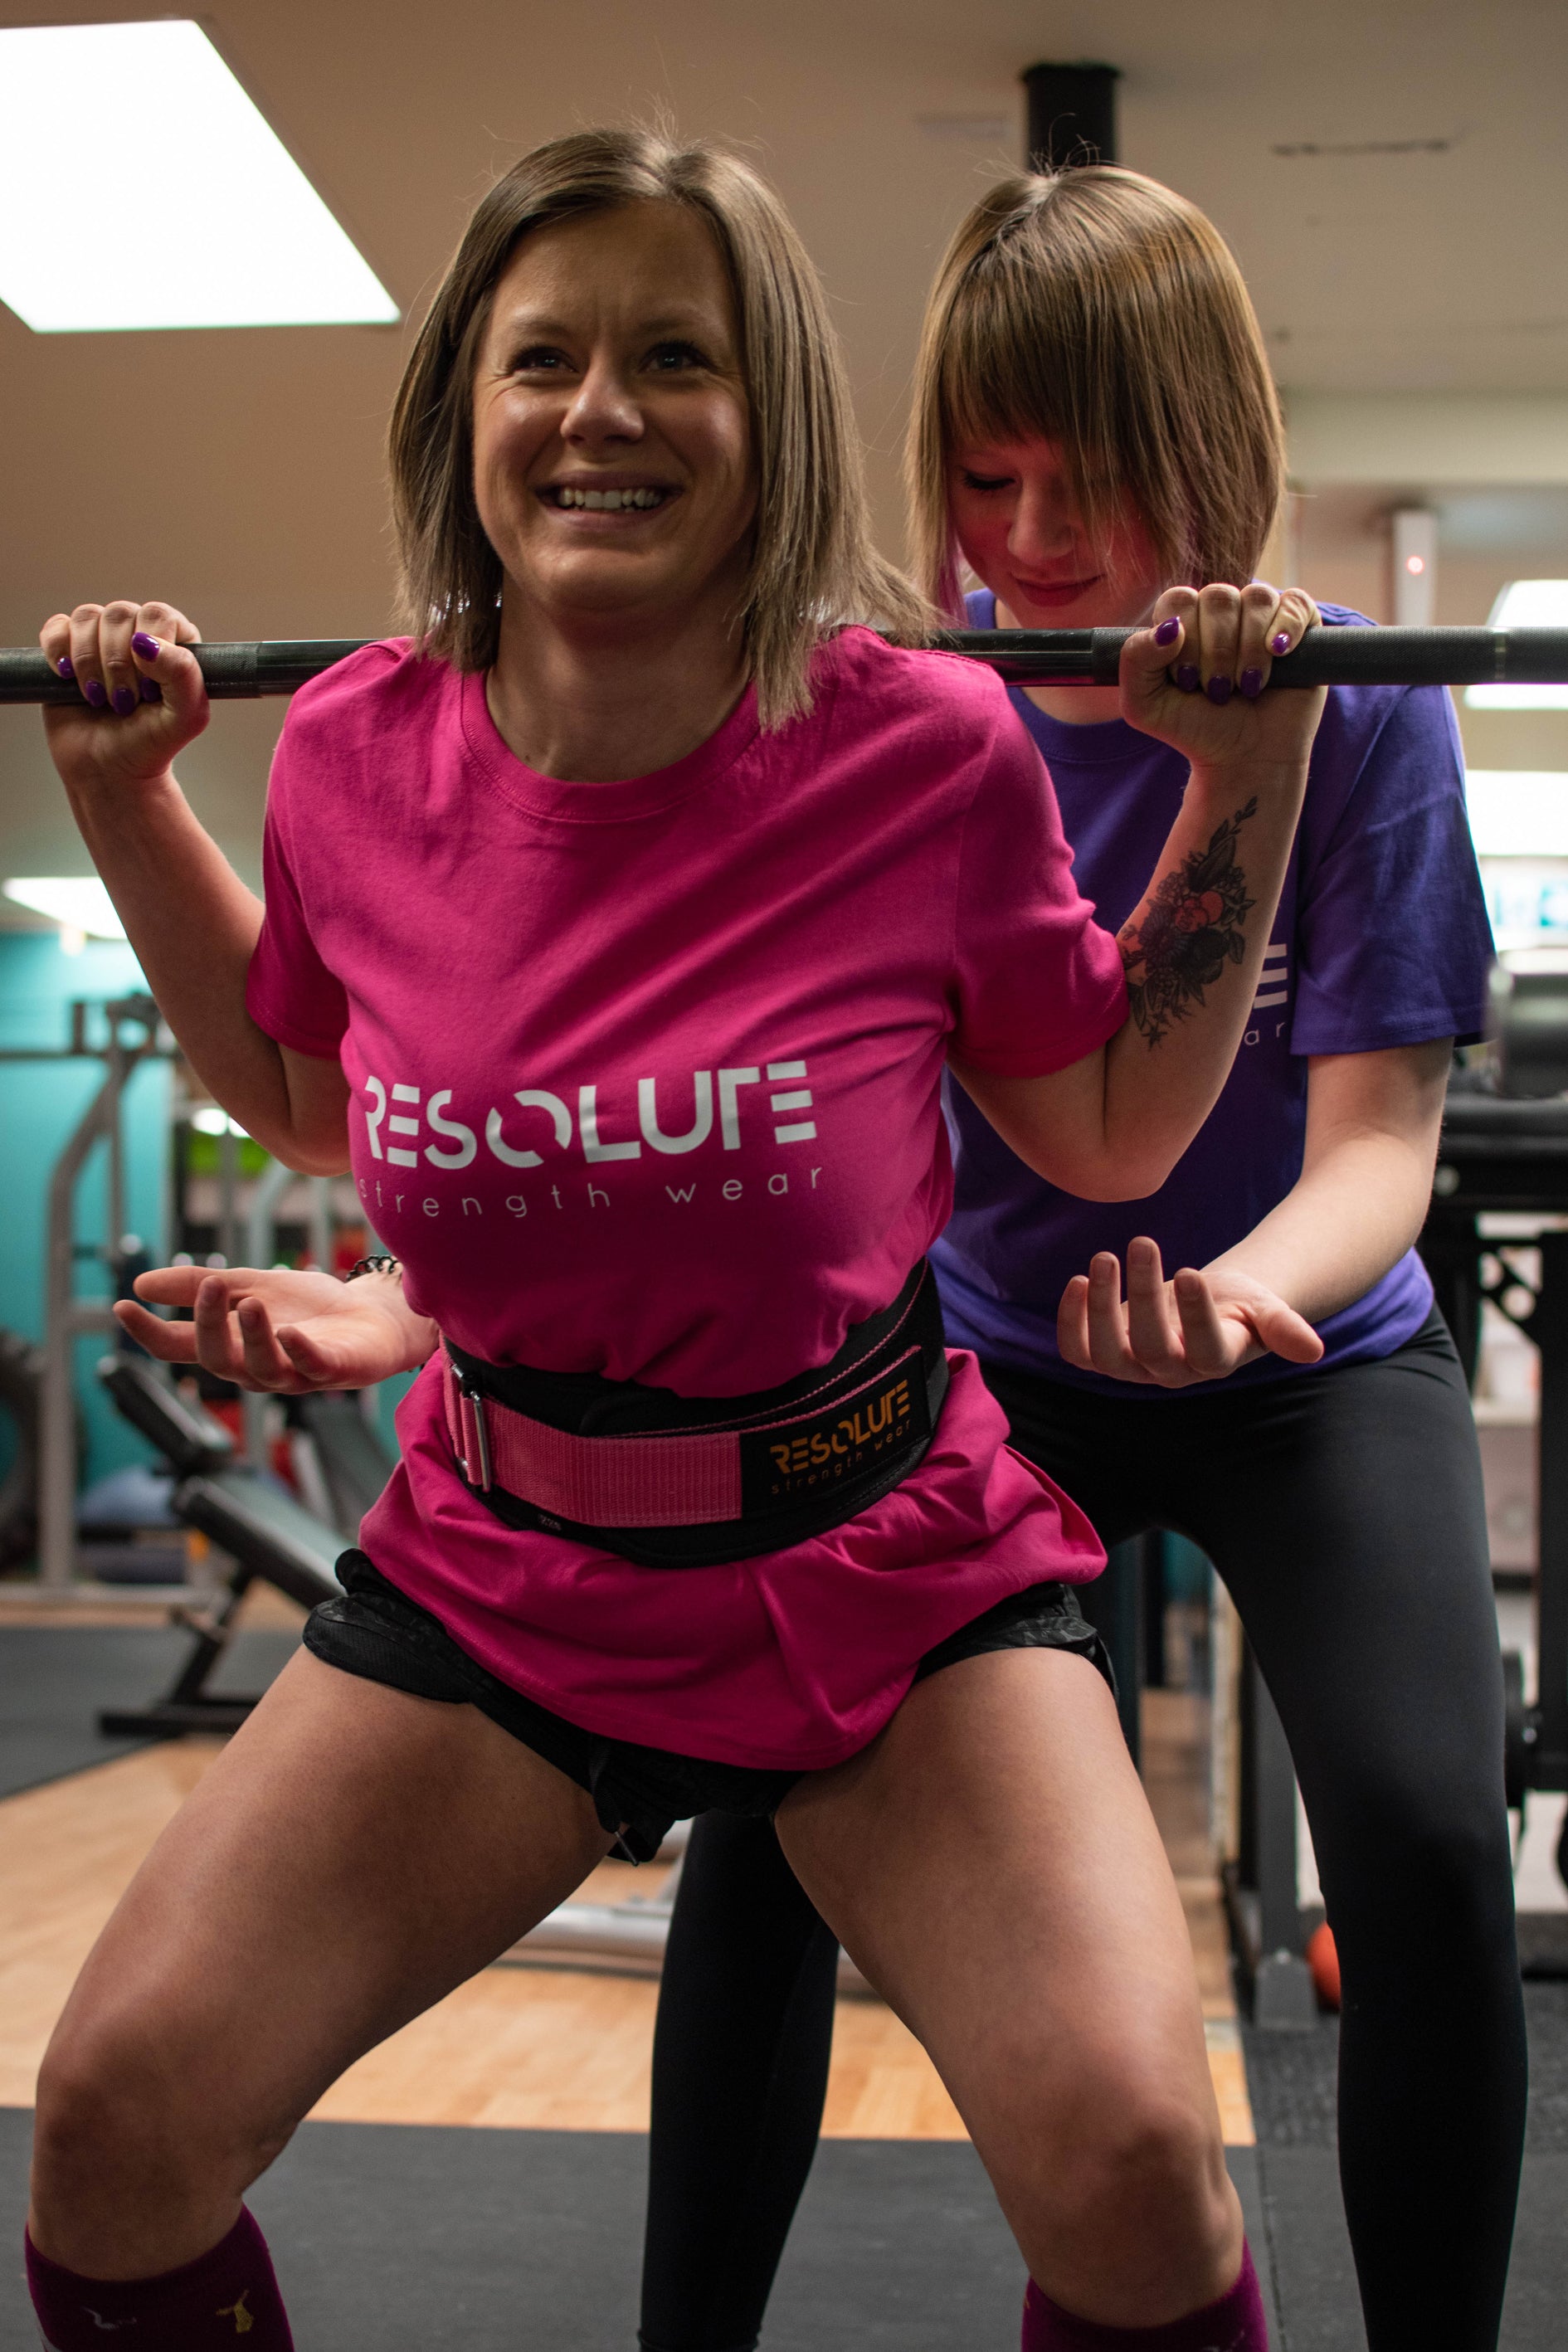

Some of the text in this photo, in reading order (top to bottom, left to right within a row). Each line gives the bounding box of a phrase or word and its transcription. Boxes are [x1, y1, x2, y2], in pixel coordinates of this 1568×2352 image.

[1244, 1022, 1285, 1045] ar
[364, 1060, 817, 1170] RESOLUTE
[359, 1166, 823, 1218] strength wear
[770, 1379, 911, 1474] RESOLUTE
[772, 1419, 911, 1494] strength wear
